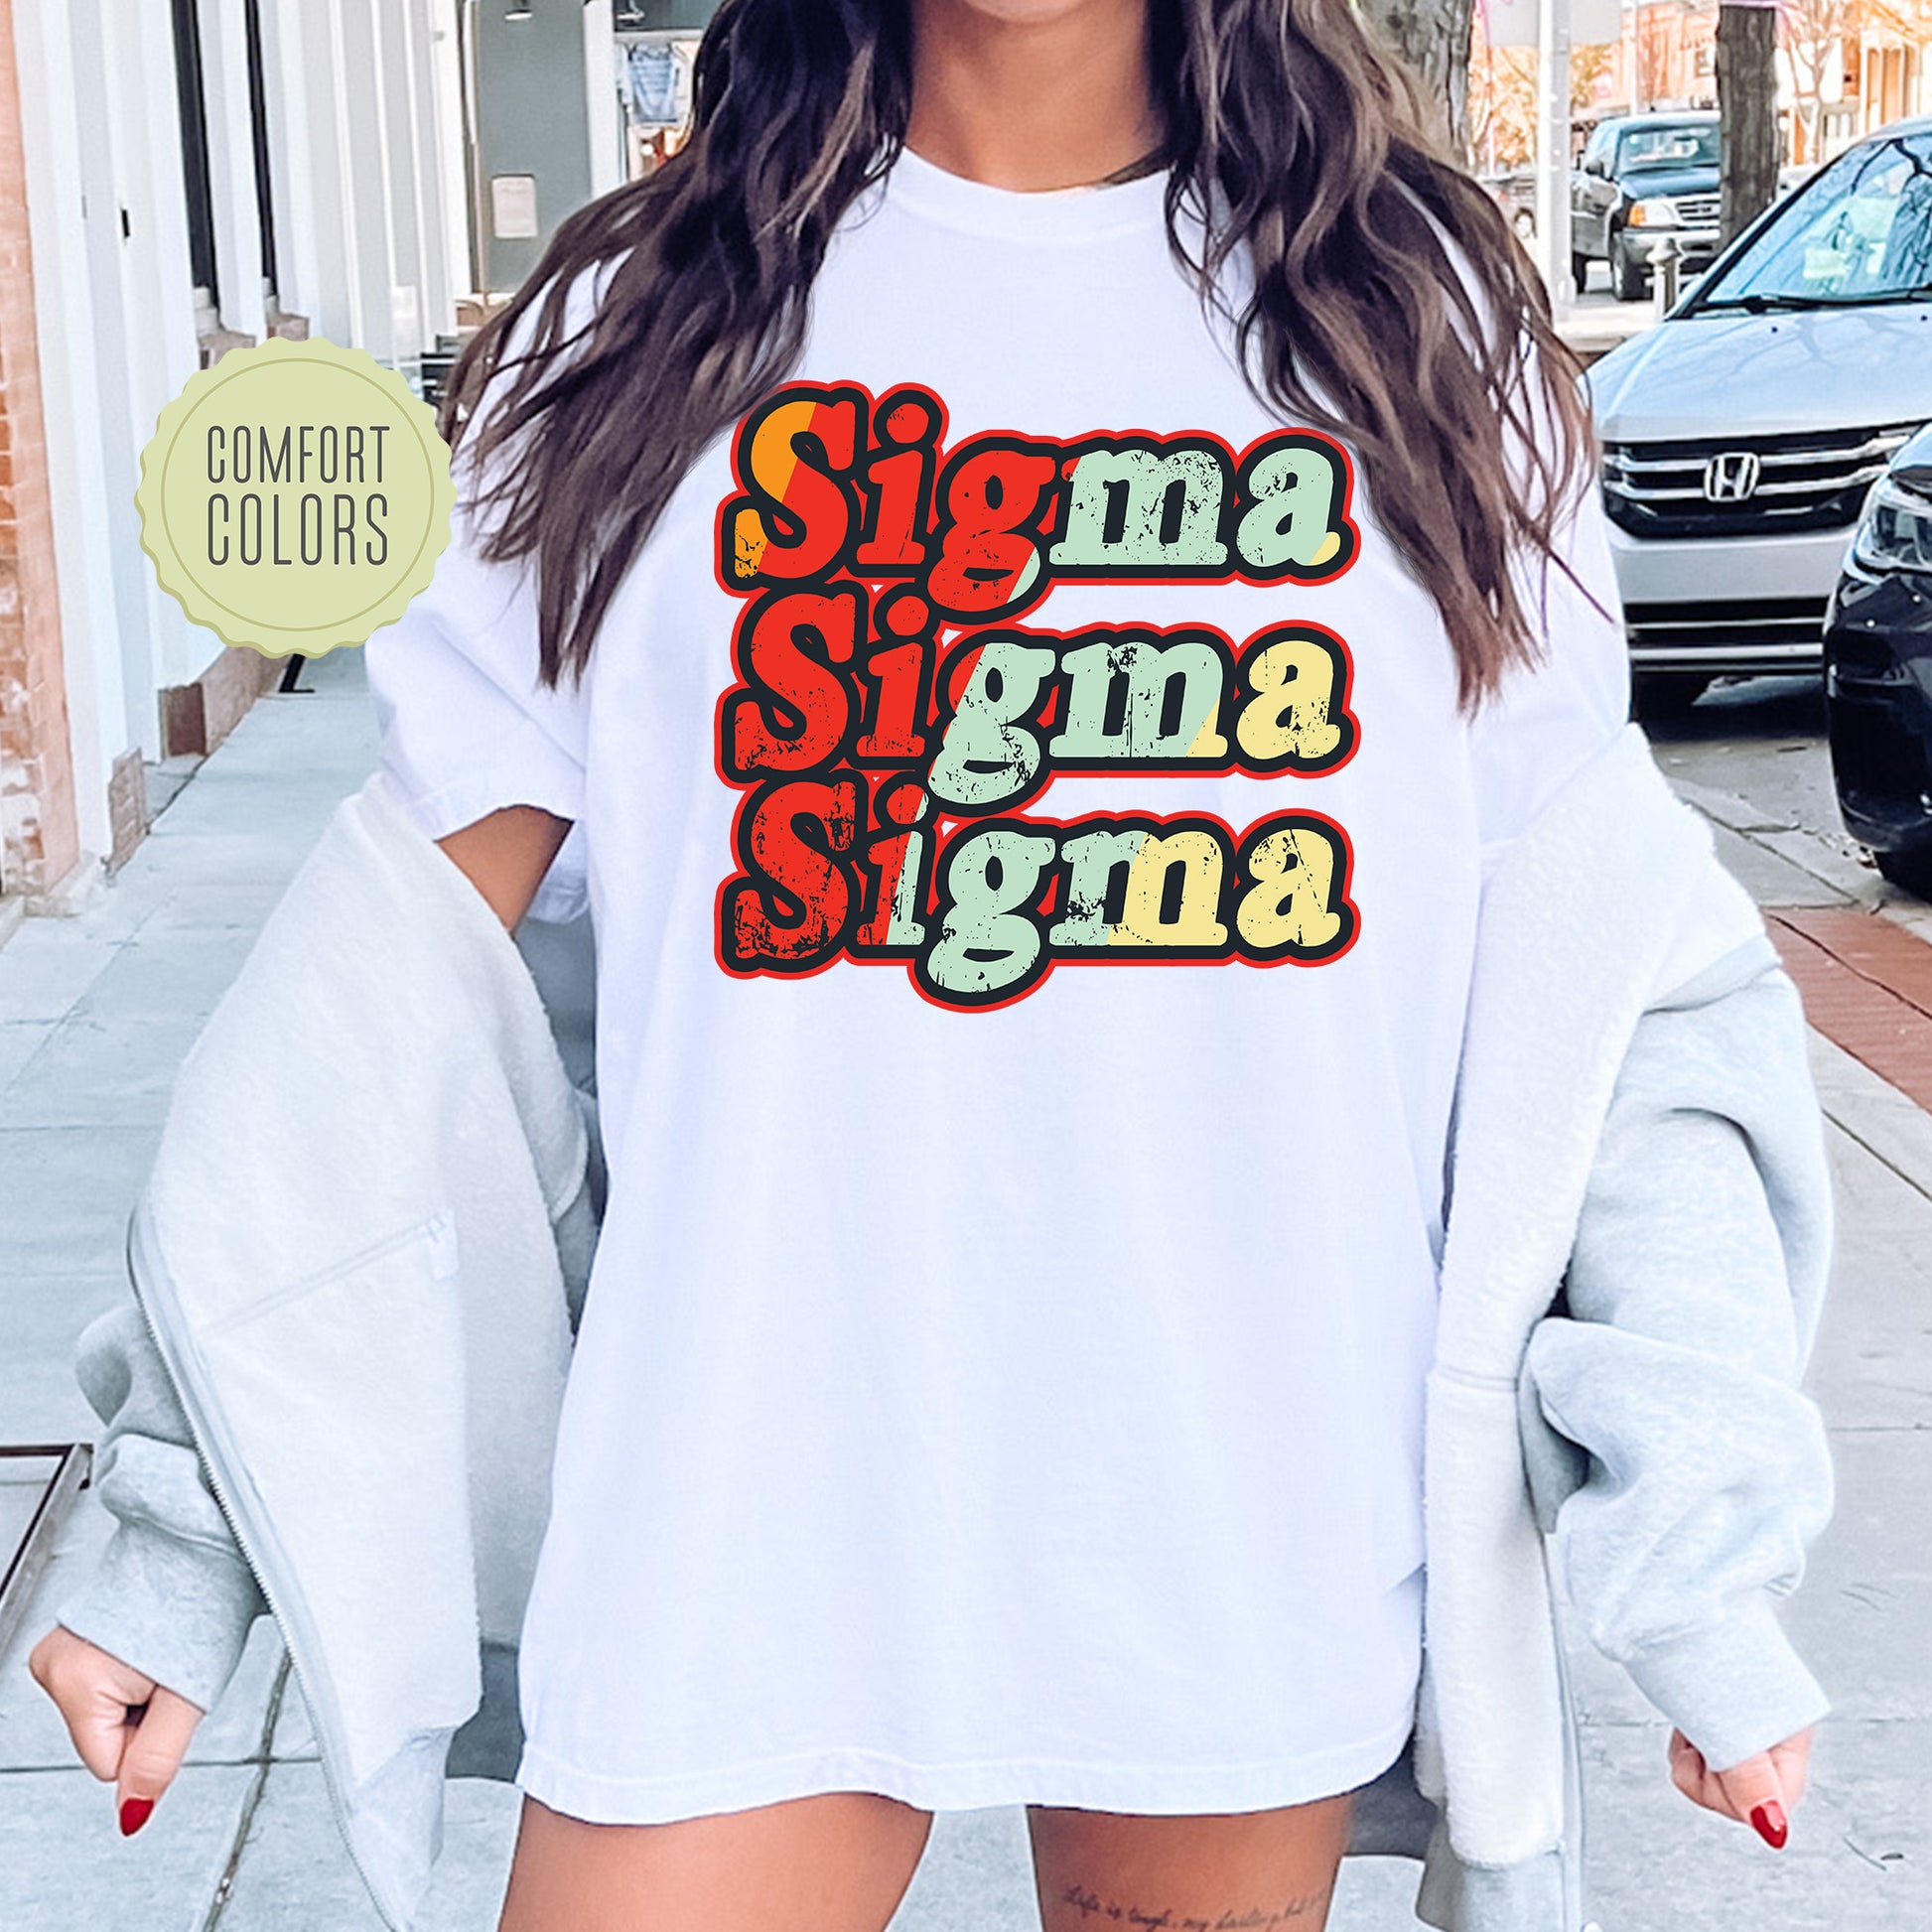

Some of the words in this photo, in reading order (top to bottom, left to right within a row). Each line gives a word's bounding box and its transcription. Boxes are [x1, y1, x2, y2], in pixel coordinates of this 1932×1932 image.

[733, 398, 1343, 614] Sigma
[733, 591, 1343, 806] Sigma
[733, 779, 1343, 994] Sigma
